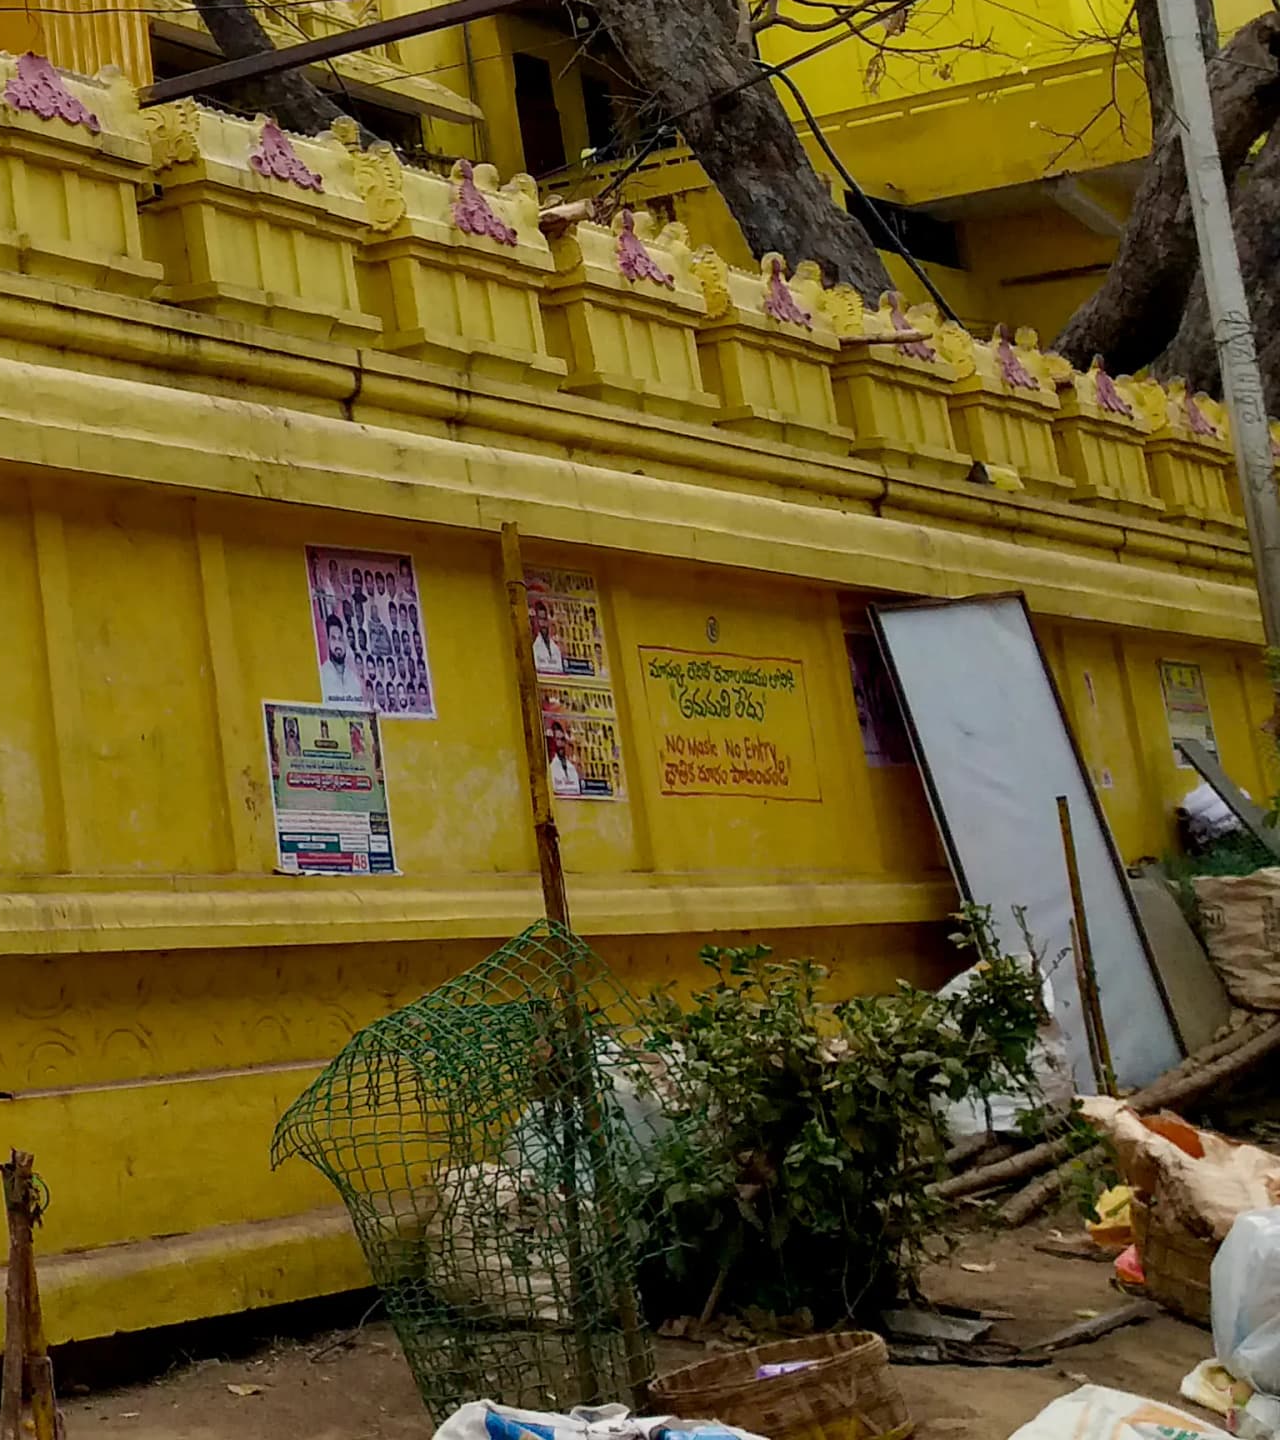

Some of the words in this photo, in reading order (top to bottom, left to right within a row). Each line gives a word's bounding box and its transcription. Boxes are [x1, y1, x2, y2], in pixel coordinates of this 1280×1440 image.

[687, 729, 718, 758] Mask
[725, 737, 742, 759] No
[743, 733, 778, 770] Entry
